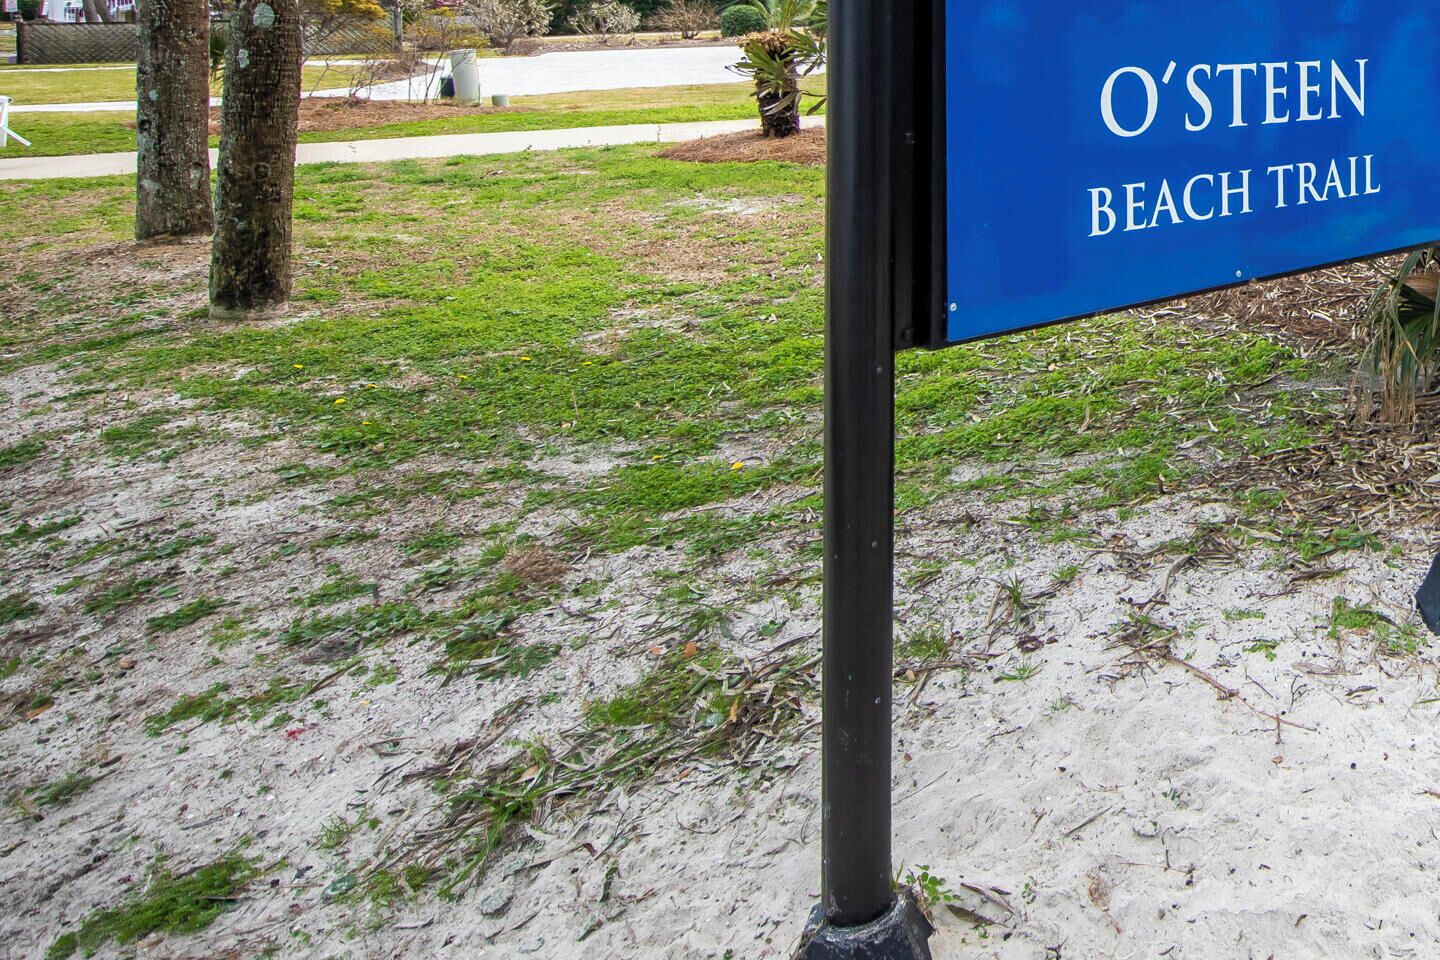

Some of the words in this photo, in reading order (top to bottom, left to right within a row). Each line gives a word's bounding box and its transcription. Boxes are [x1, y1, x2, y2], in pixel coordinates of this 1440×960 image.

[1100, 58, 1368, 138] O'STEEN
[1087, 168, 1253, 237] BEACH
[1266, 154, 1381, 208] TRAIL
